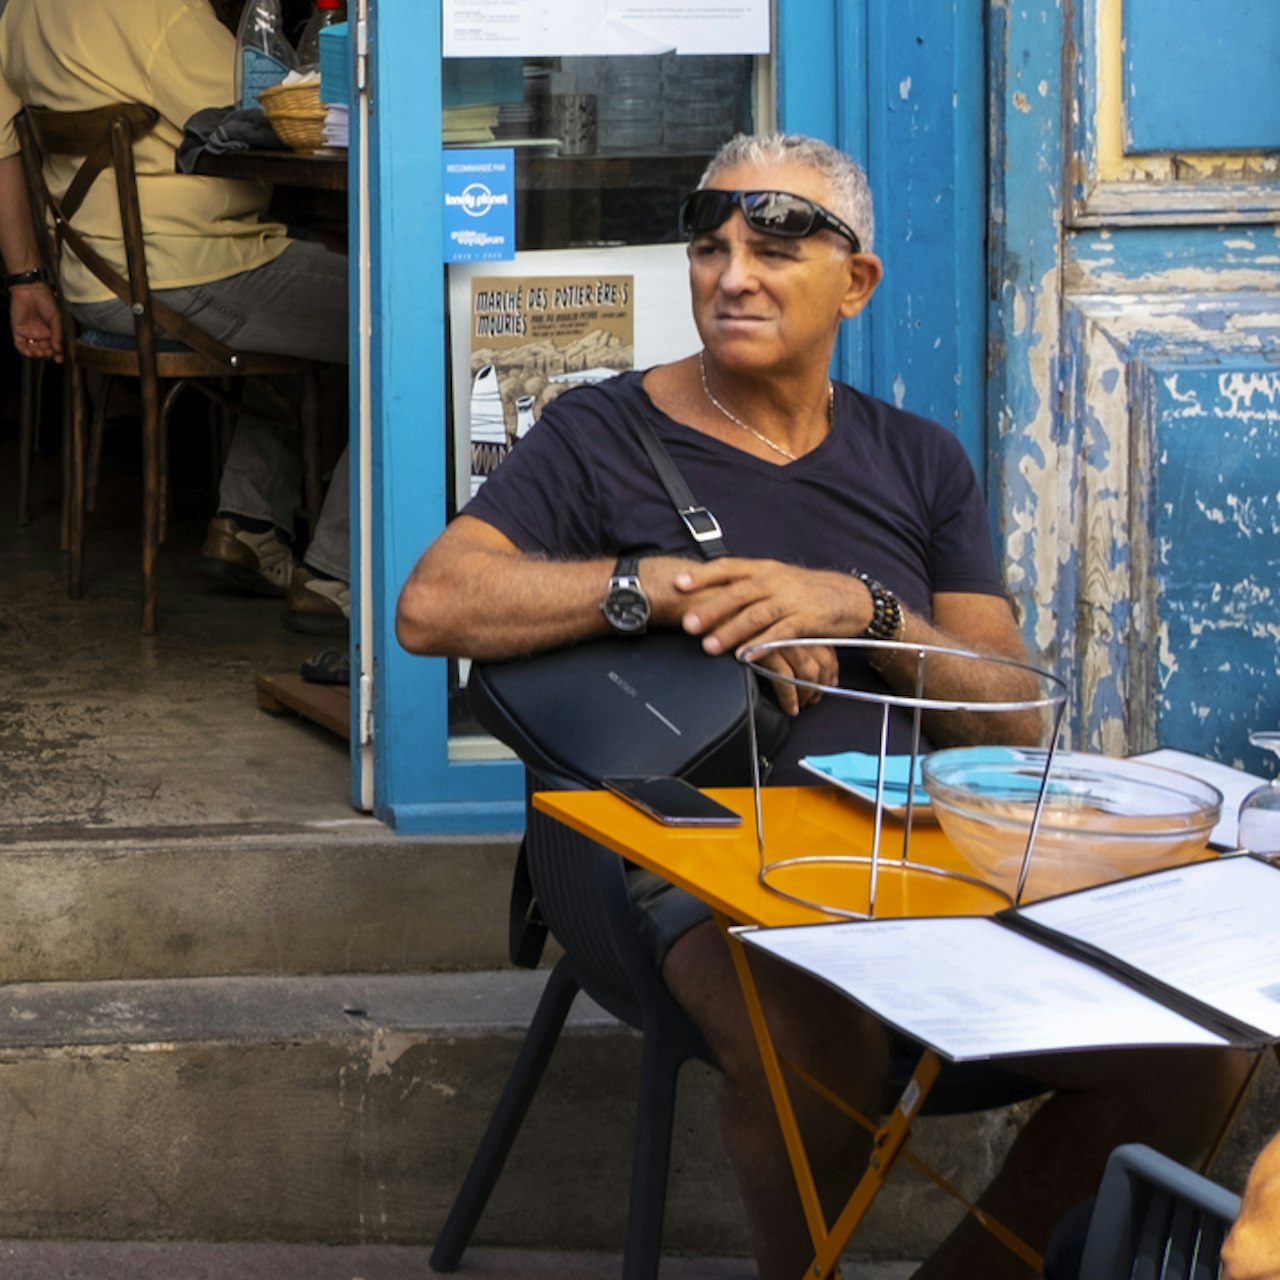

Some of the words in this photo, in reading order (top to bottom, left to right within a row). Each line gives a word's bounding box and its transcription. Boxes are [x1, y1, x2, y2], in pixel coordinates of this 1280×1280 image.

[444, 192, 475, 209] lonely
[476, 192, 508, 208] planet
[475, 285, 522, 314] MARCHÉ
[526, 288, 548, 312] DES
